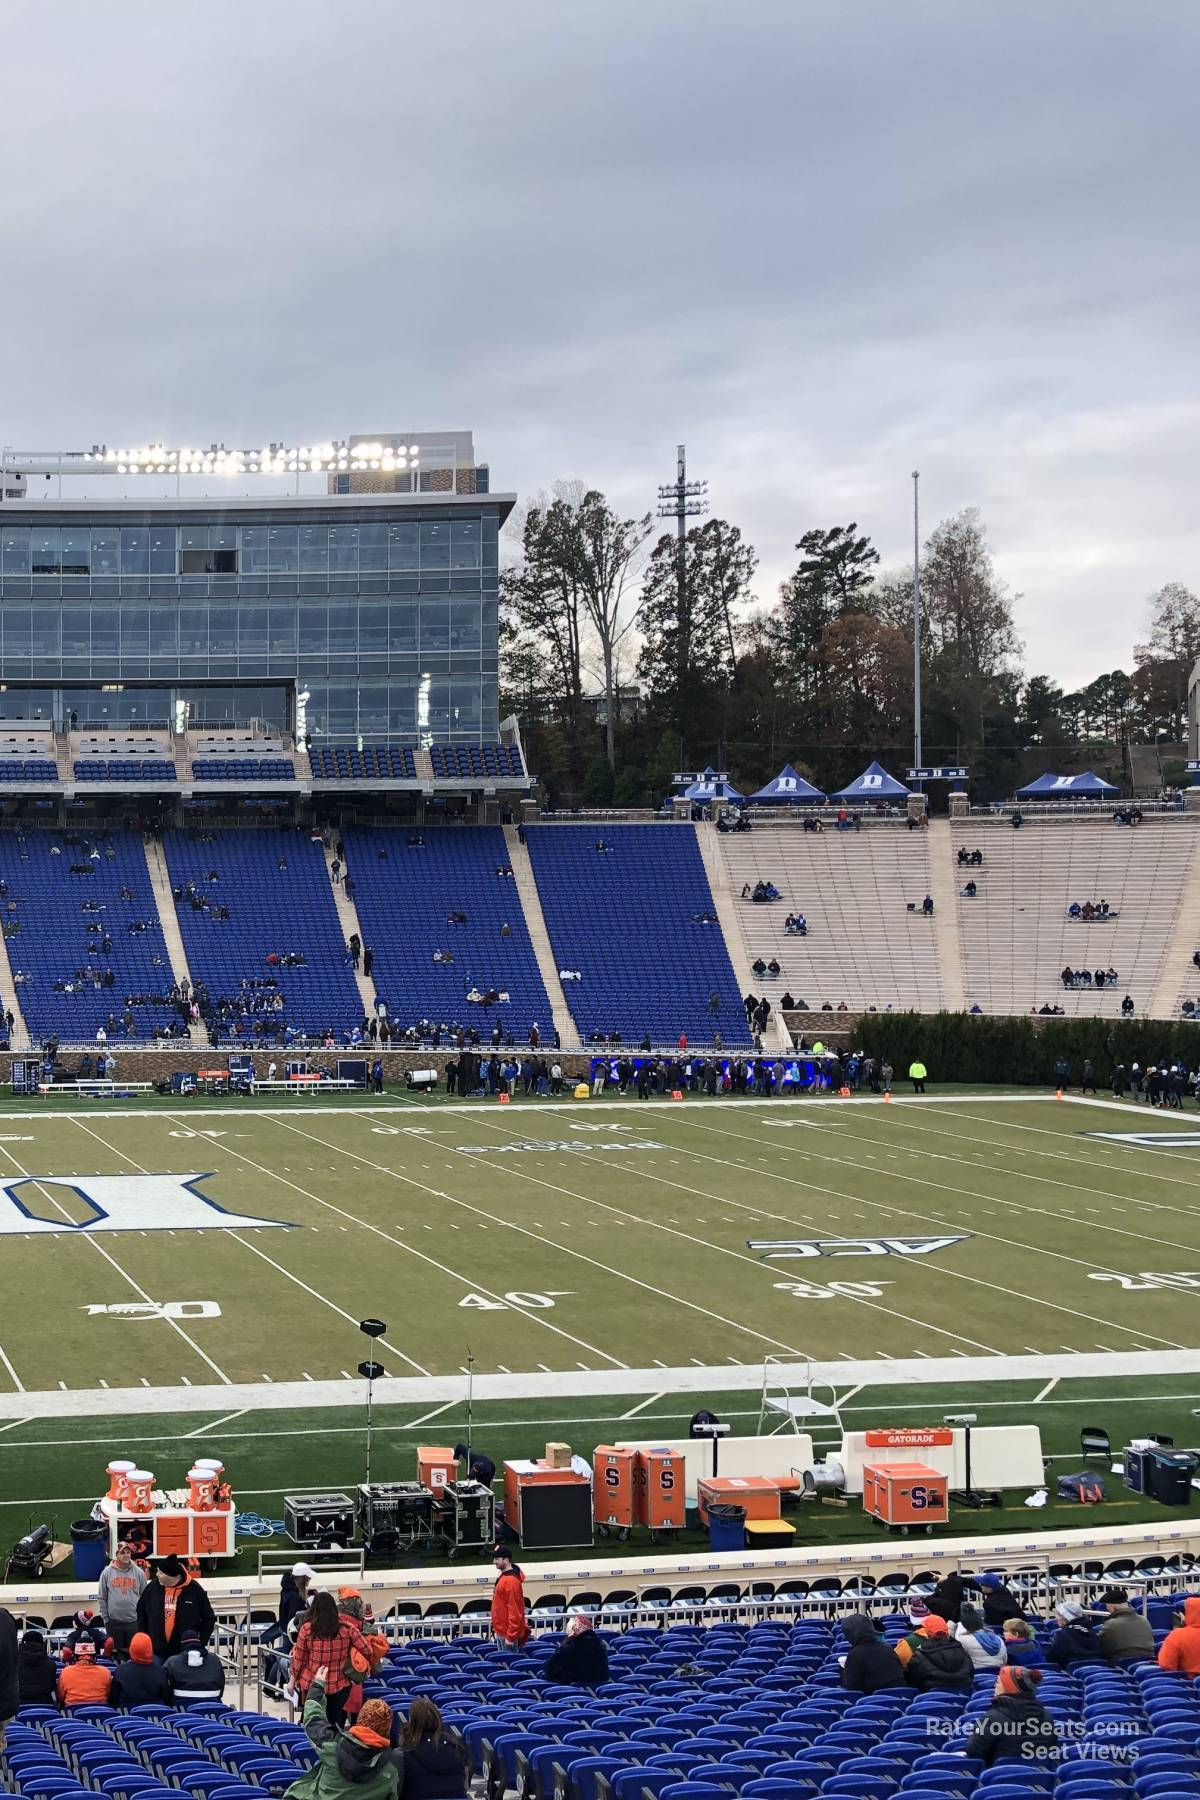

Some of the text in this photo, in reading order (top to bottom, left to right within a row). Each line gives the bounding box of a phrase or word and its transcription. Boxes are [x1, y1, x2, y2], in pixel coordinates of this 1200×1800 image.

[746, 1233, 976, 1259] ACC
[773, 1280, 885, 1299] 30
[1087, 1272, 1200, 1290] 20
[458, 1292, 556, 1311] 40
[887, 1434, 935, 1444] GATORADE
[605, 1467, 620, 1487] S
[659, 1470, 675, 1490] S
[135, 1486, 147, 1498] G
[199, 1485, 210, 1496] G
[911, 1485, 928, 1510] S
[201, 1520, 221, 1547] S
